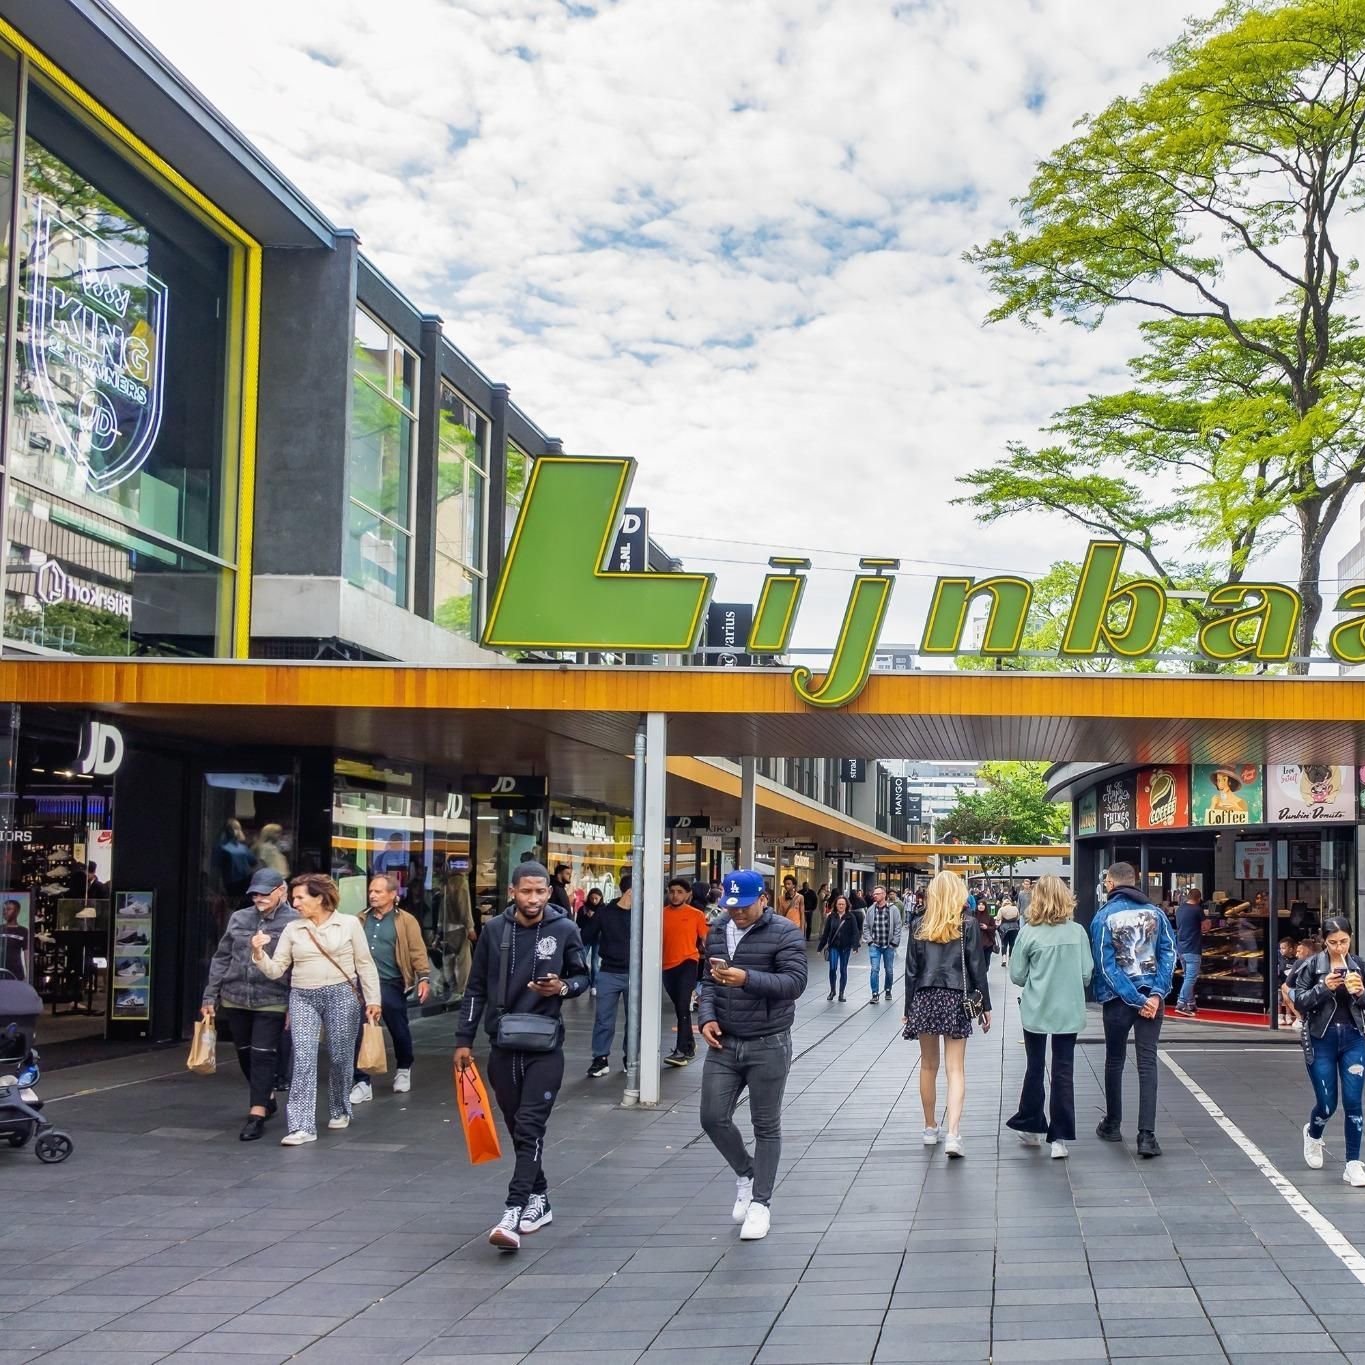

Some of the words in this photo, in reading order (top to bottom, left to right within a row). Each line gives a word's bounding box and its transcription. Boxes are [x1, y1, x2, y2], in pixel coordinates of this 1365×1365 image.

[52, 286, 150, 382] KING
[67, 345, 148, 405] TRAINERS
[82, 721, 125, 775] JD
[490, 776, 516, 792] JD
[895, 778, 903, 815] MANGO
[443, 792, 463, 820] JD
[1150, 799, 1177, 824] COFFEE
[1208, 809, 1247, 825] Coffee
[675, 816, 692, 828] JD
[1103, 811, 1131, 831] THINGS
[730, 880, 740, 893] LA
